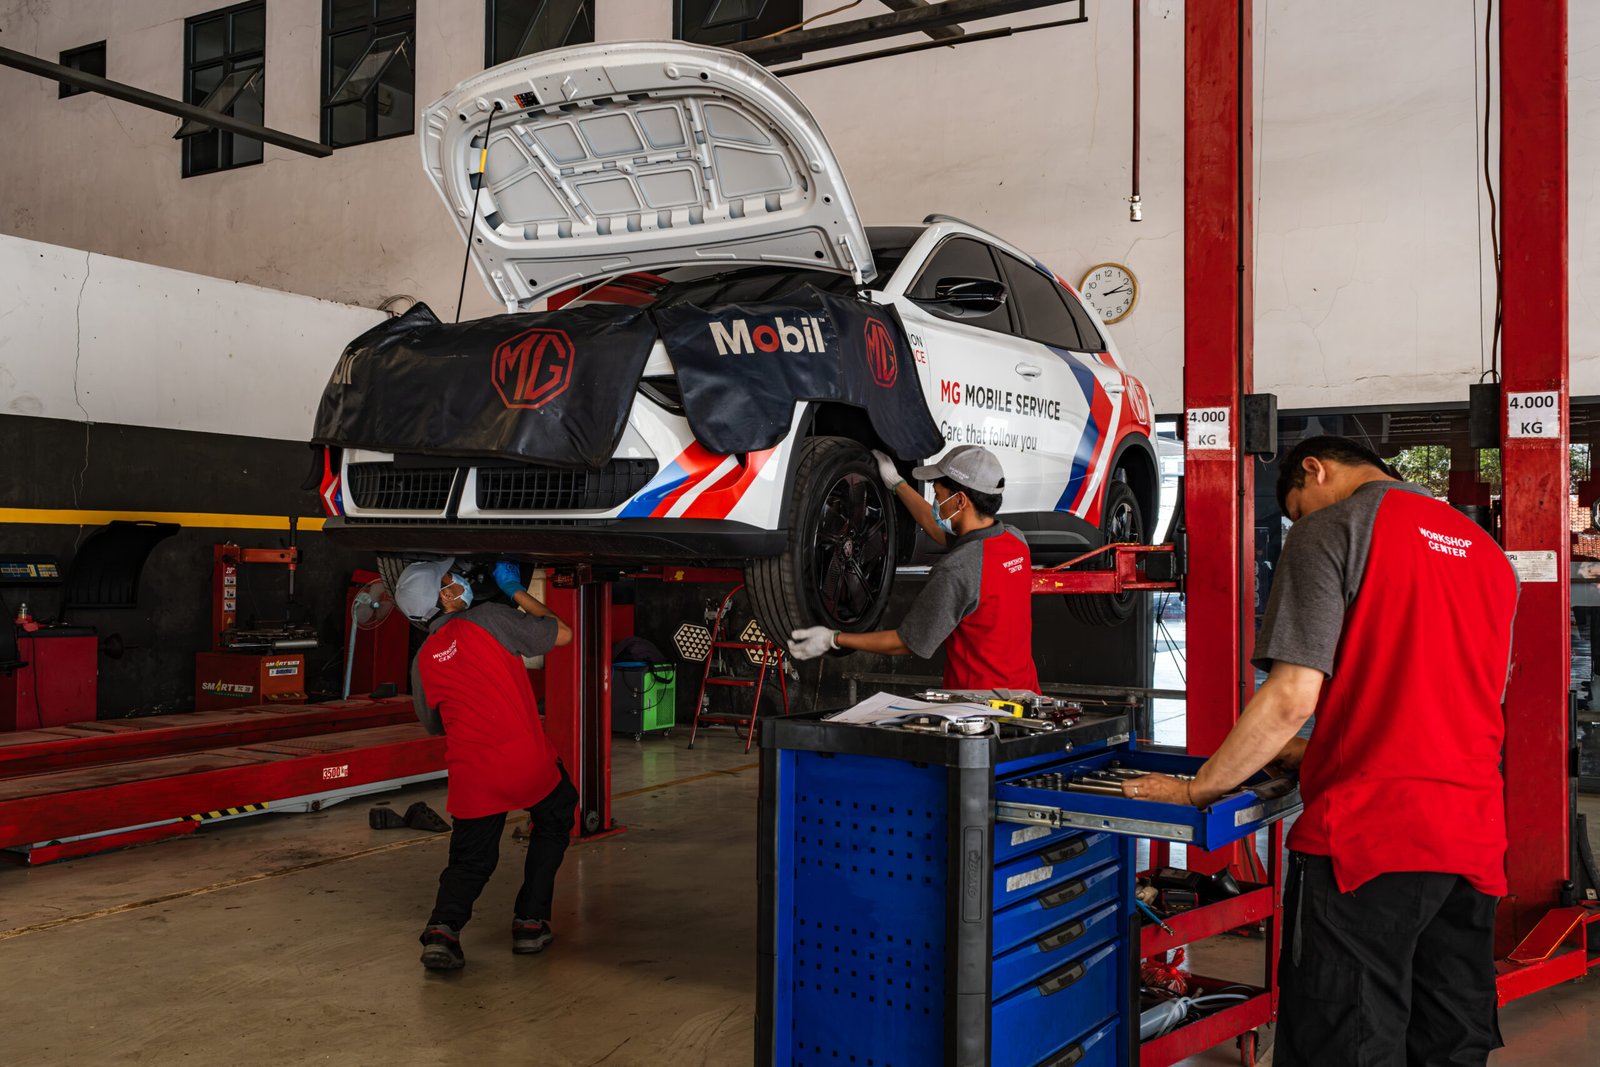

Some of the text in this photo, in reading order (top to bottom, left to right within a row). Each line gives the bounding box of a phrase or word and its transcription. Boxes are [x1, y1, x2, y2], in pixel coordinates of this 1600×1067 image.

[1104, 269, 1112, 277] 12
[1089, 281, 1097, 289] 10
[1123, 277, 1129, 285] 2
[1085, 292, 1091, 300] 9
[1126, 287, 1133, 295] 3
[1106, 310, 1112, 318] 6
[709, 316, 826, 356] Mobil
[863, 318, 898, 386] MG
[496, 331, 571, 404] MG
[940, 379, 1061, 421] MG MOBILE SERVICE
[1509, 395, 1554, 409] 4.000
[1189, 411, 1226, 423] 4.000
[1521, 421, 1543, 434] KG
[941, 420, 1038, 452] Care that follow you
[1198, 434, 1217, 445] KG
[1418, 526, 1472, 548] WORKSHOP
[1428, 540, 1467, 558] CENTER
